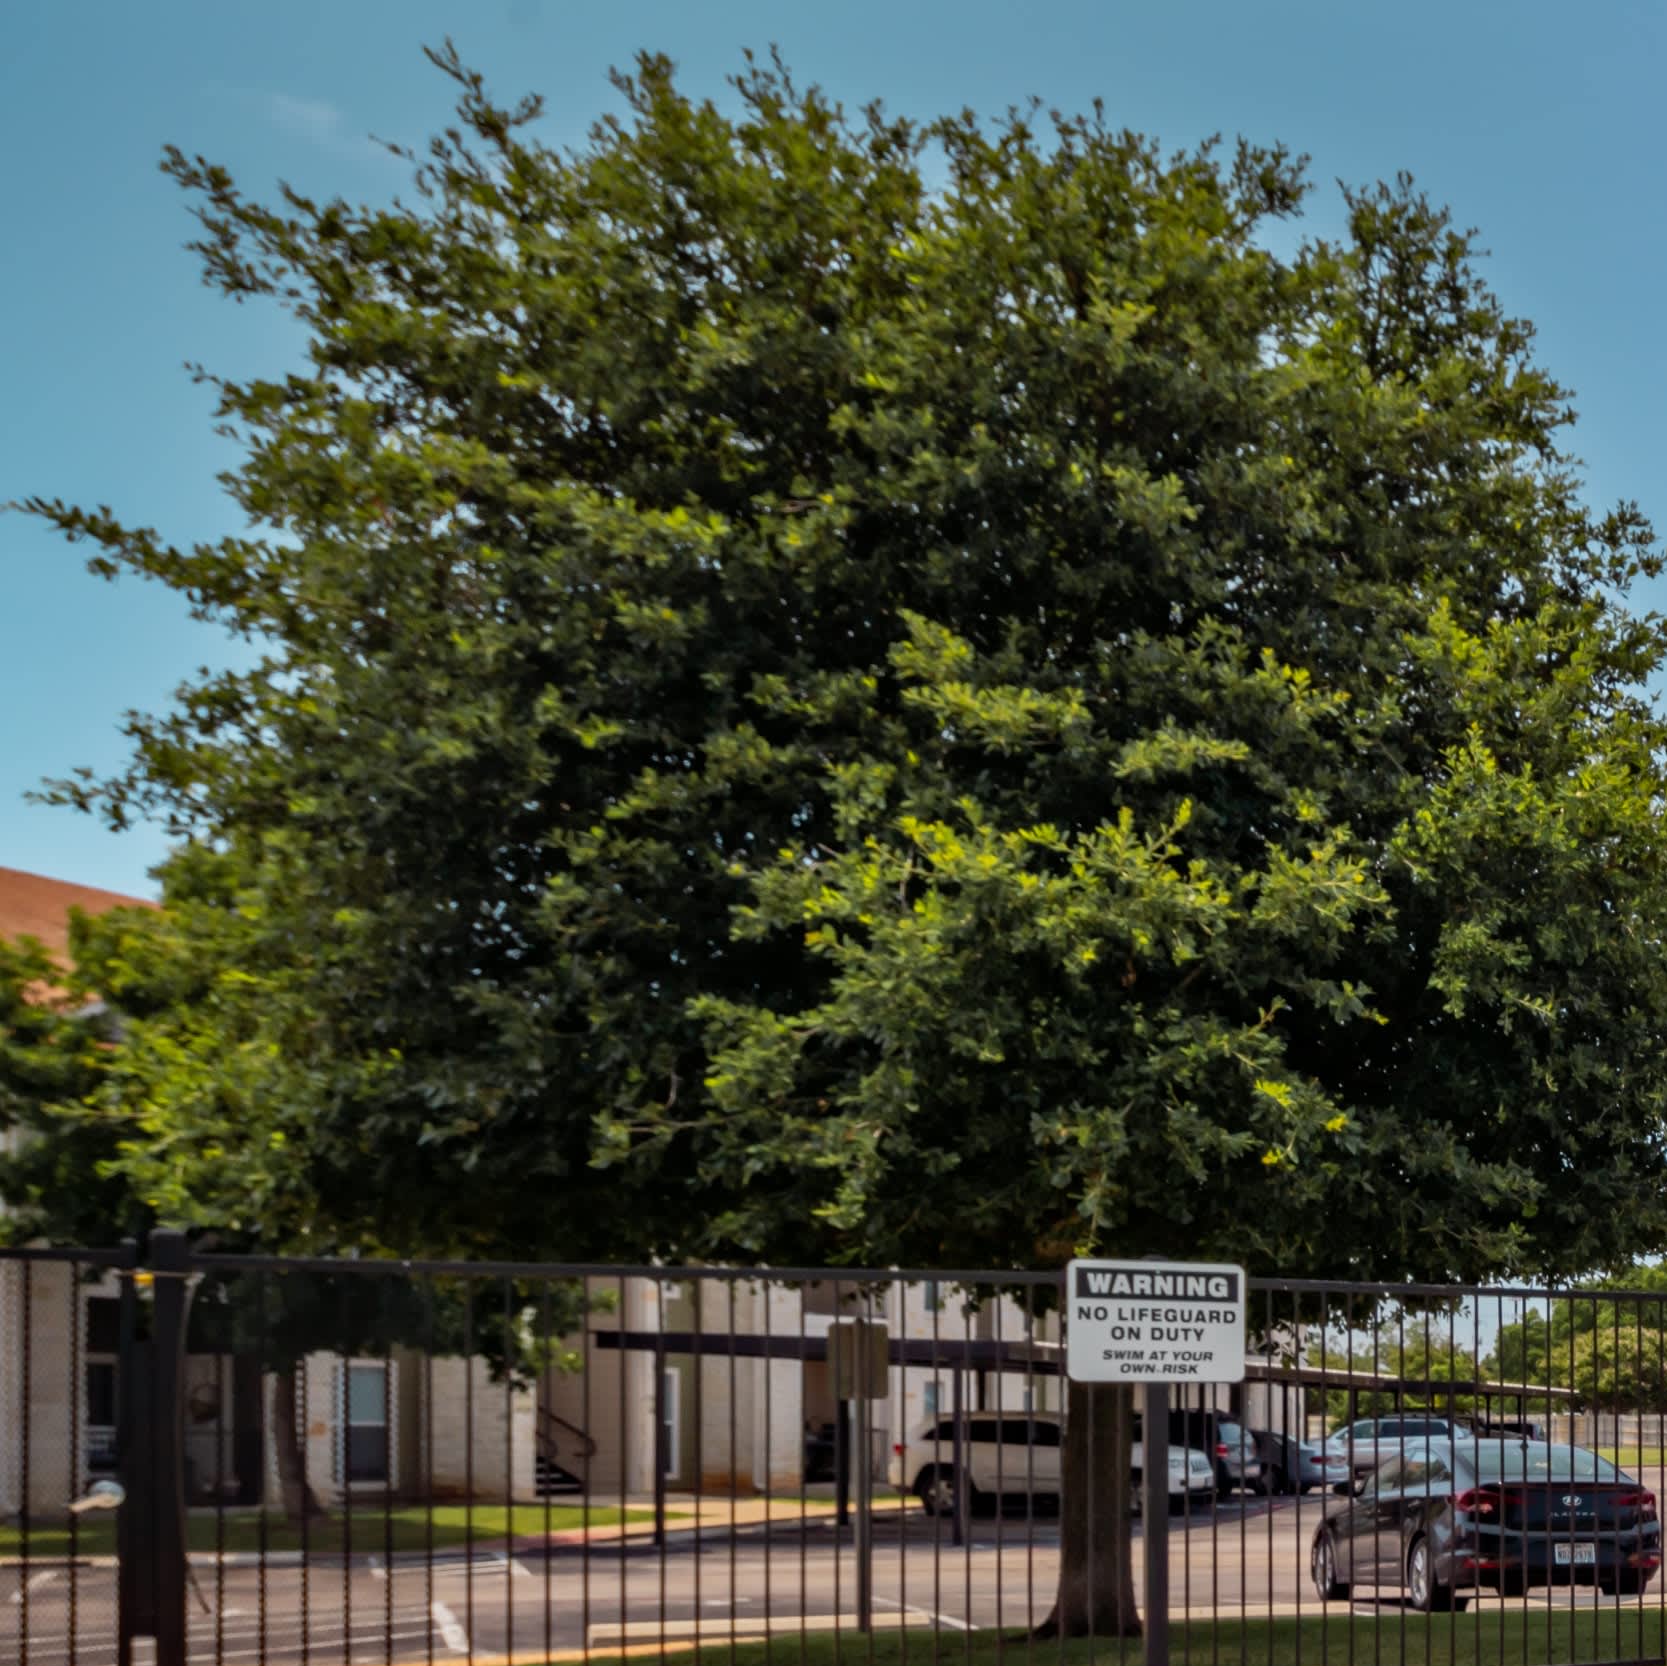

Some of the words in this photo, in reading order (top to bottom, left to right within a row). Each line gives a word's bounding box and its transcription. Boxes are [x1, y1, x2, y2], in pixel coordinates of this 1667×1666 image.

[1087, 1273, 1228, 1298] WARNING
[1078, 1306, 1108, 1321] NO
[1118, 1307, 1236, 1324] LIFEGUARD
[1111, 1326, 1140, 1340] ON
[1151, 1327, 1204, 1342] DUTY
[1103, 1350, 1143, 1361] SWIM
[1149, 1351, 1168, 1361] AT
[1173, 1351, 1213, 1361] YOUR
[1120, 1363, 1156, 1374] OWN
[1162, 1364, 1198, 1374] RISK
